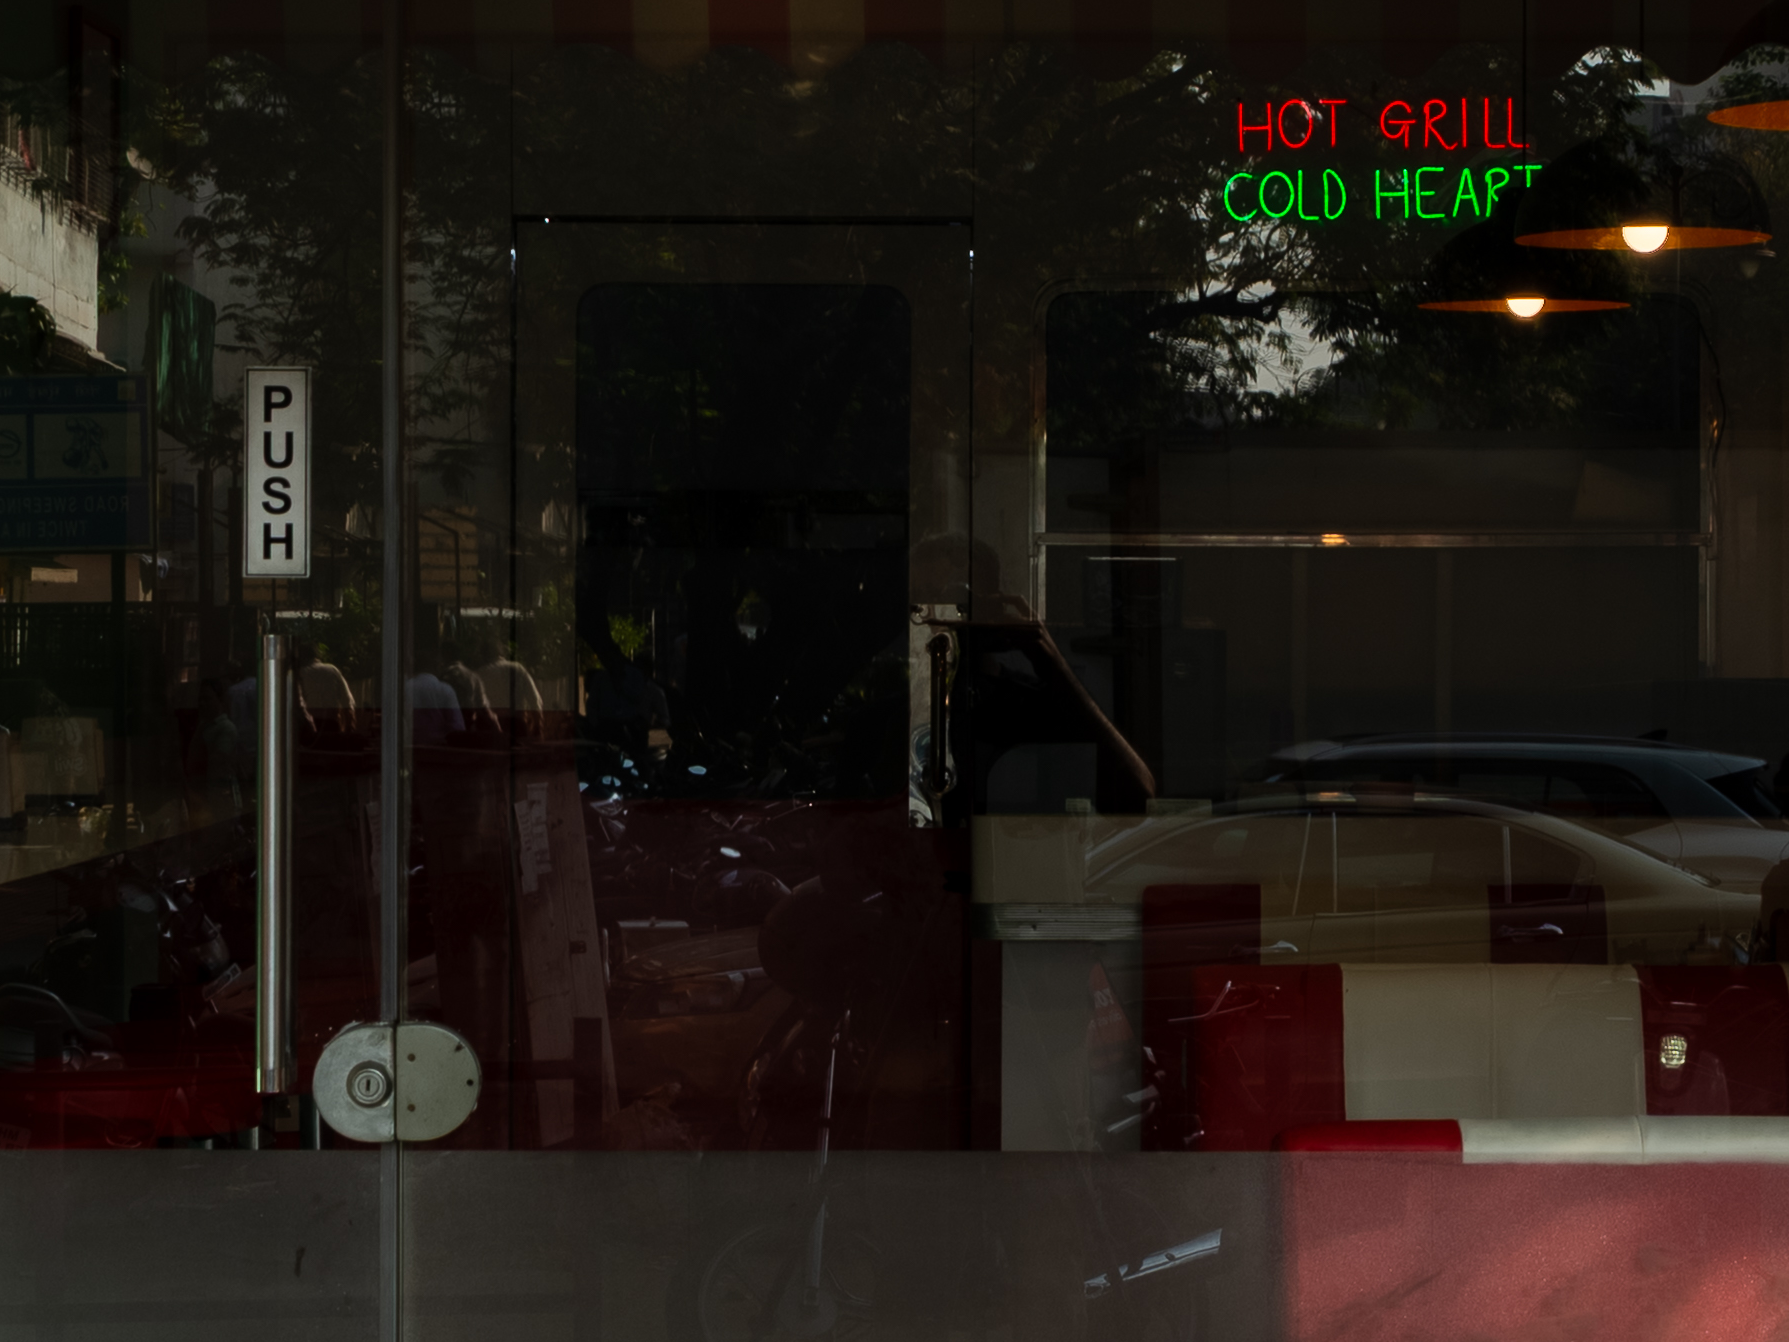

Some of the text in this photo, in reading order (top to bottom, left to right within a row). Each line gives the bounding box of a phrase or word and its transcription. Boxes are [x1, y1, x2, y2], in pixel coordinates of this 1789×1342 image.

[1238, 96, 1531, 152] HOT GRILL
[1222, 167, 1348, 222] COLD
[262, 385, 294, 560] PUSH
